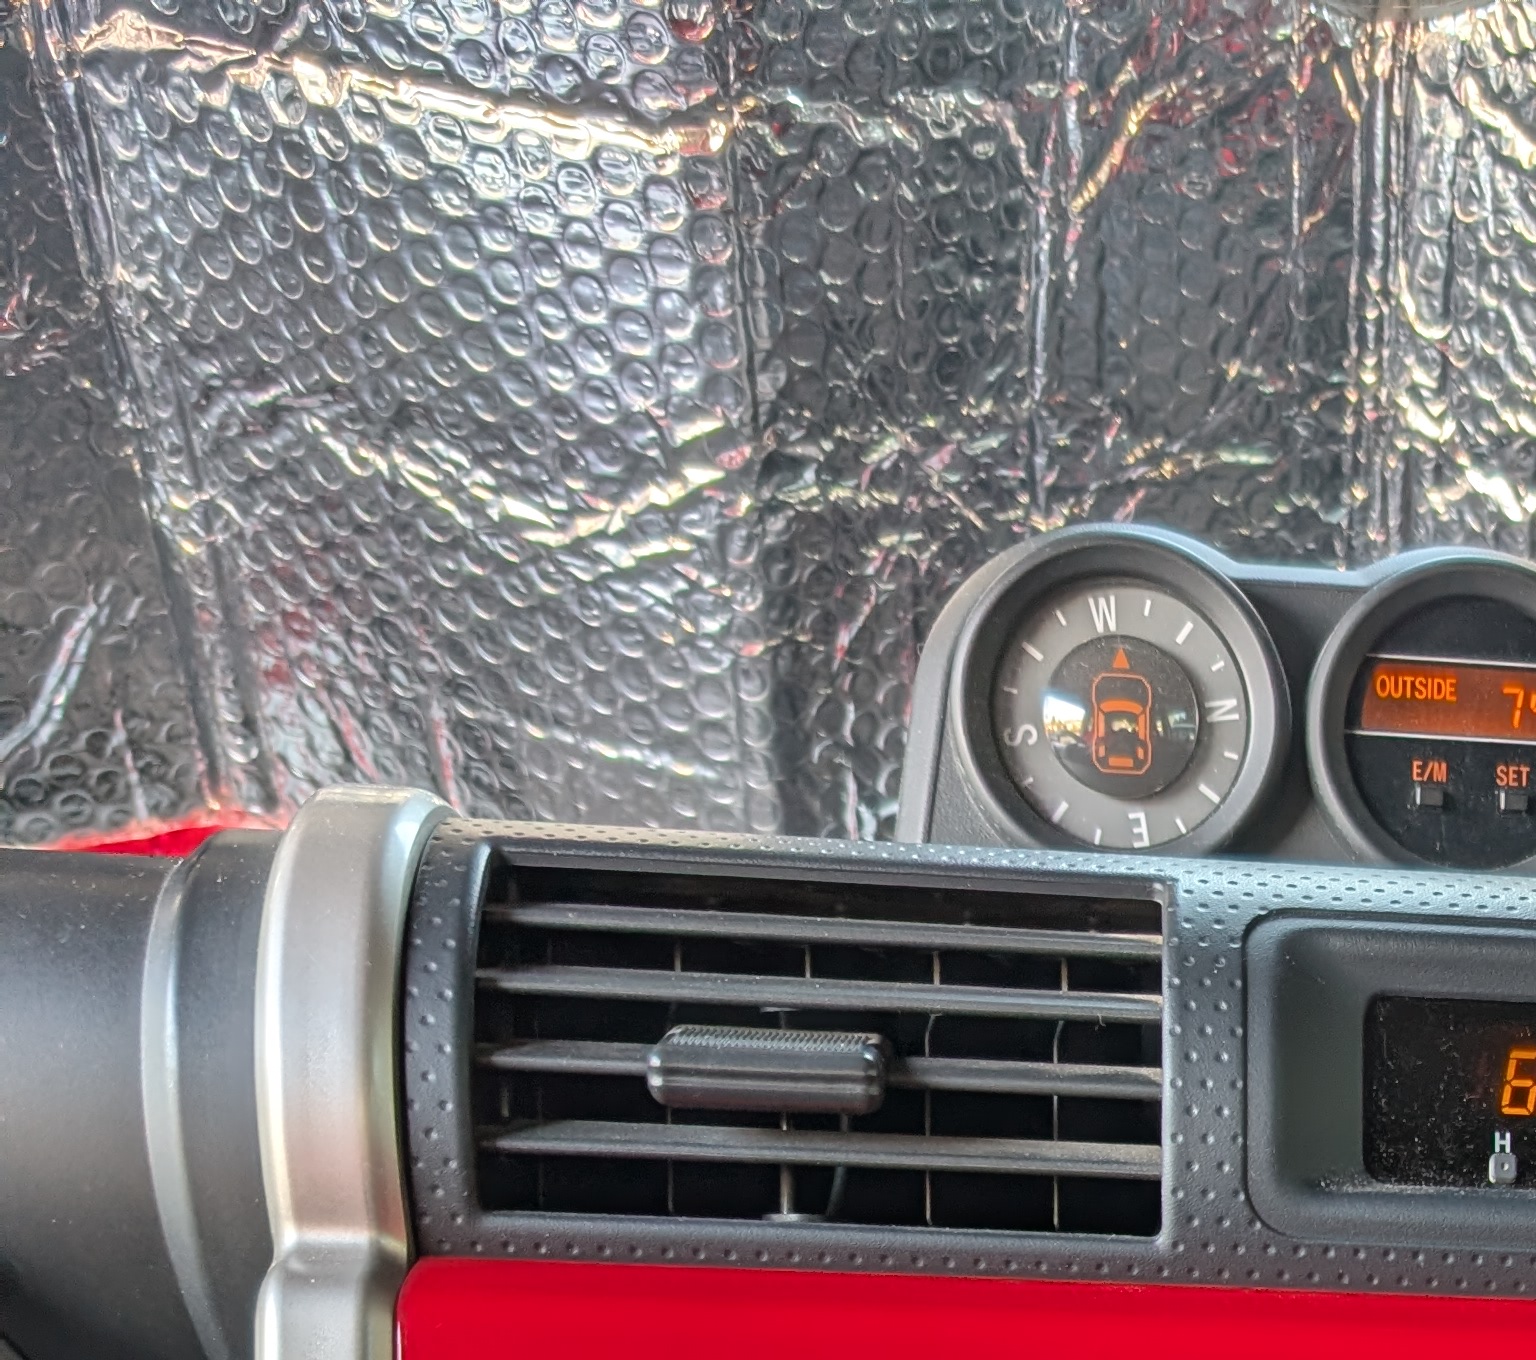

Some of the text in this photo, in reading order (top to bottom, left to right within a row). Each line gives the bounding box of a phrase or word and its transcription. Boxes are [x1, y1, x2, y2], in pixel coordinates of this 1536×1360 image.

[1088, 595, 1117, 633] W
[1375, 675, 1457, 702] OUTSIDE
[1204, 698, 1239, 724] N
[1004, 723, 1038, 747] S
[1412, 760, 1448, 783] E/M
[1496, 765, 1531, 788] SET
[1128, 811, 1150, 849] E
[1494, 1131, 1511, 1153] H
